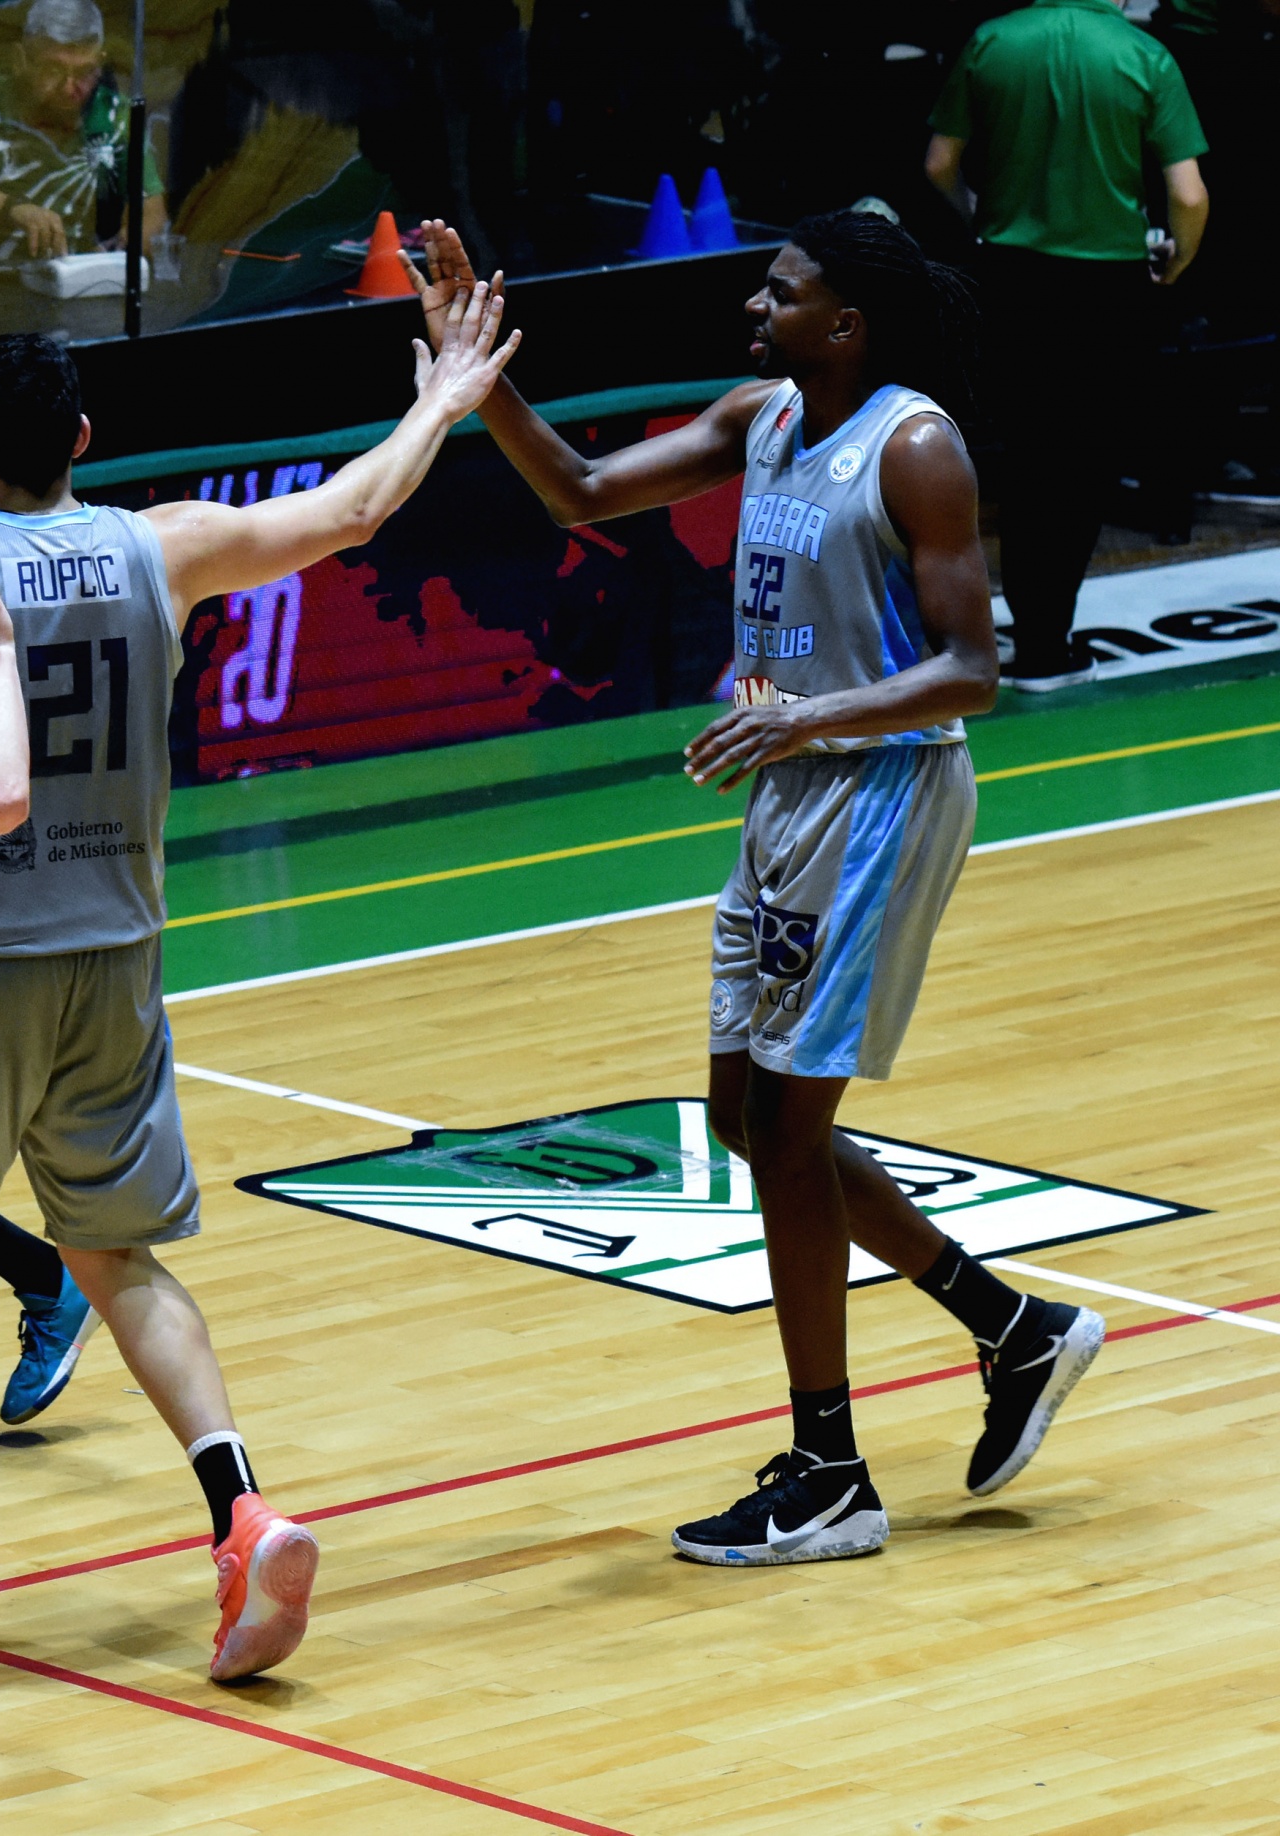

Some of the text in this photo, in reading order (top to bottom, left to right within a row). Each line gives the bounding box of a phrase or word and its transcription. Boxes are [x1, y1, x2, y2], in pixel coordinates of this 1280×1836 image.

[17, 555, 121, 602] RUPCIC
[742, 551, 786, 622] 32
[762, 624, 814, 659] CLUB
[26, 636, 129, 779] 21
[46, 821, 123, 840] Gobierno
[48, 841, 146, 862] de Misiones
